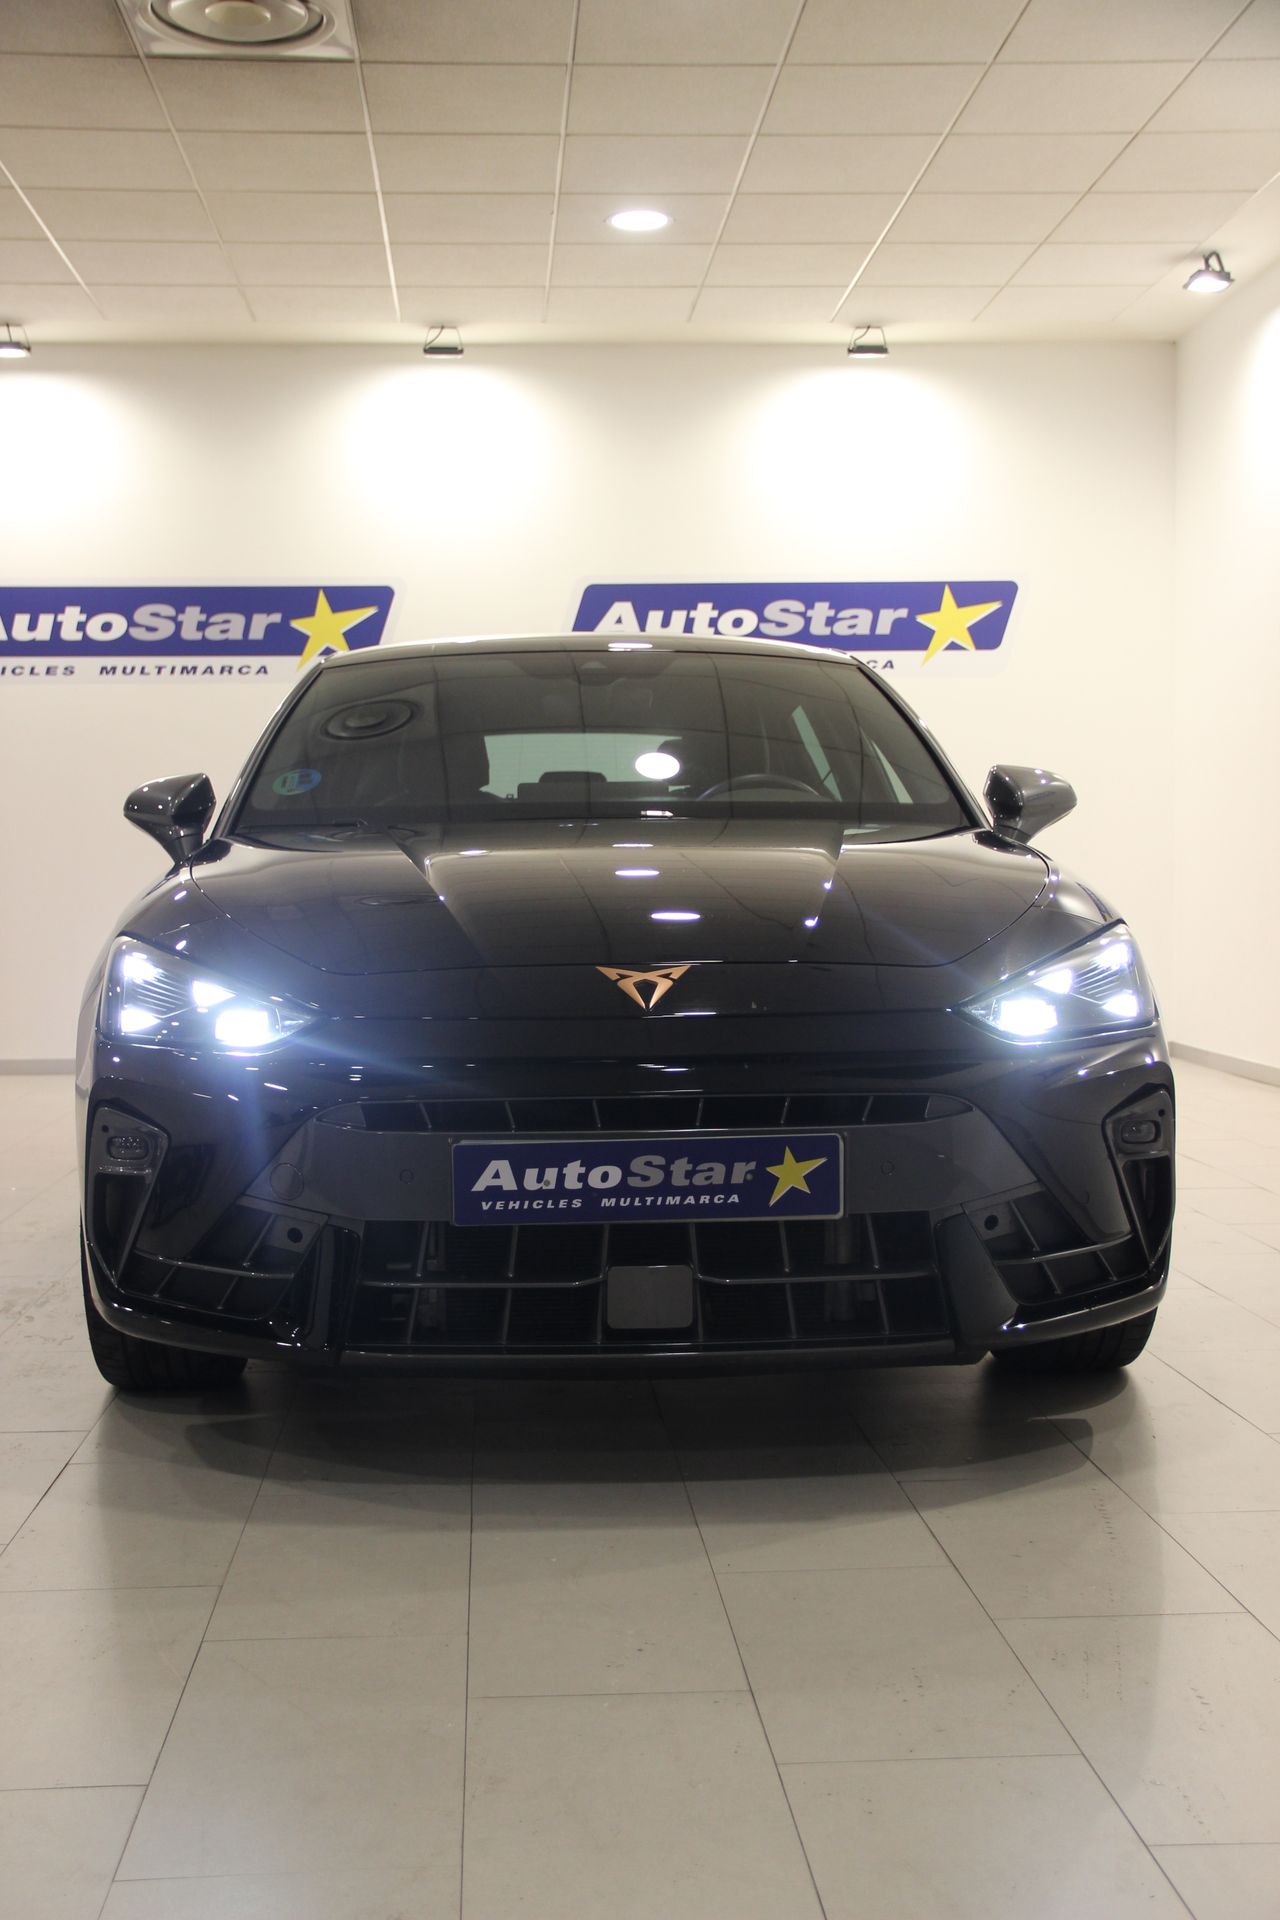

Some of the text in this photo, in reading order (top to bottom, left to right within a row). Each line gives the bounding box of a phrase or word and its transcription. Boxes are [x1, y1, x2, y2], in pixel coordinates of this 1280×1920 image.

[0, 603, 283, 642] utoStar
[594, 599, 909, 637] AutoStar
[99, 664, 270, 676] MULTIMARCA
[471, 1154, 757, 1192] AutoStar
[481, 1193, 741, 1211] VEHICLES MULTIMARCA
